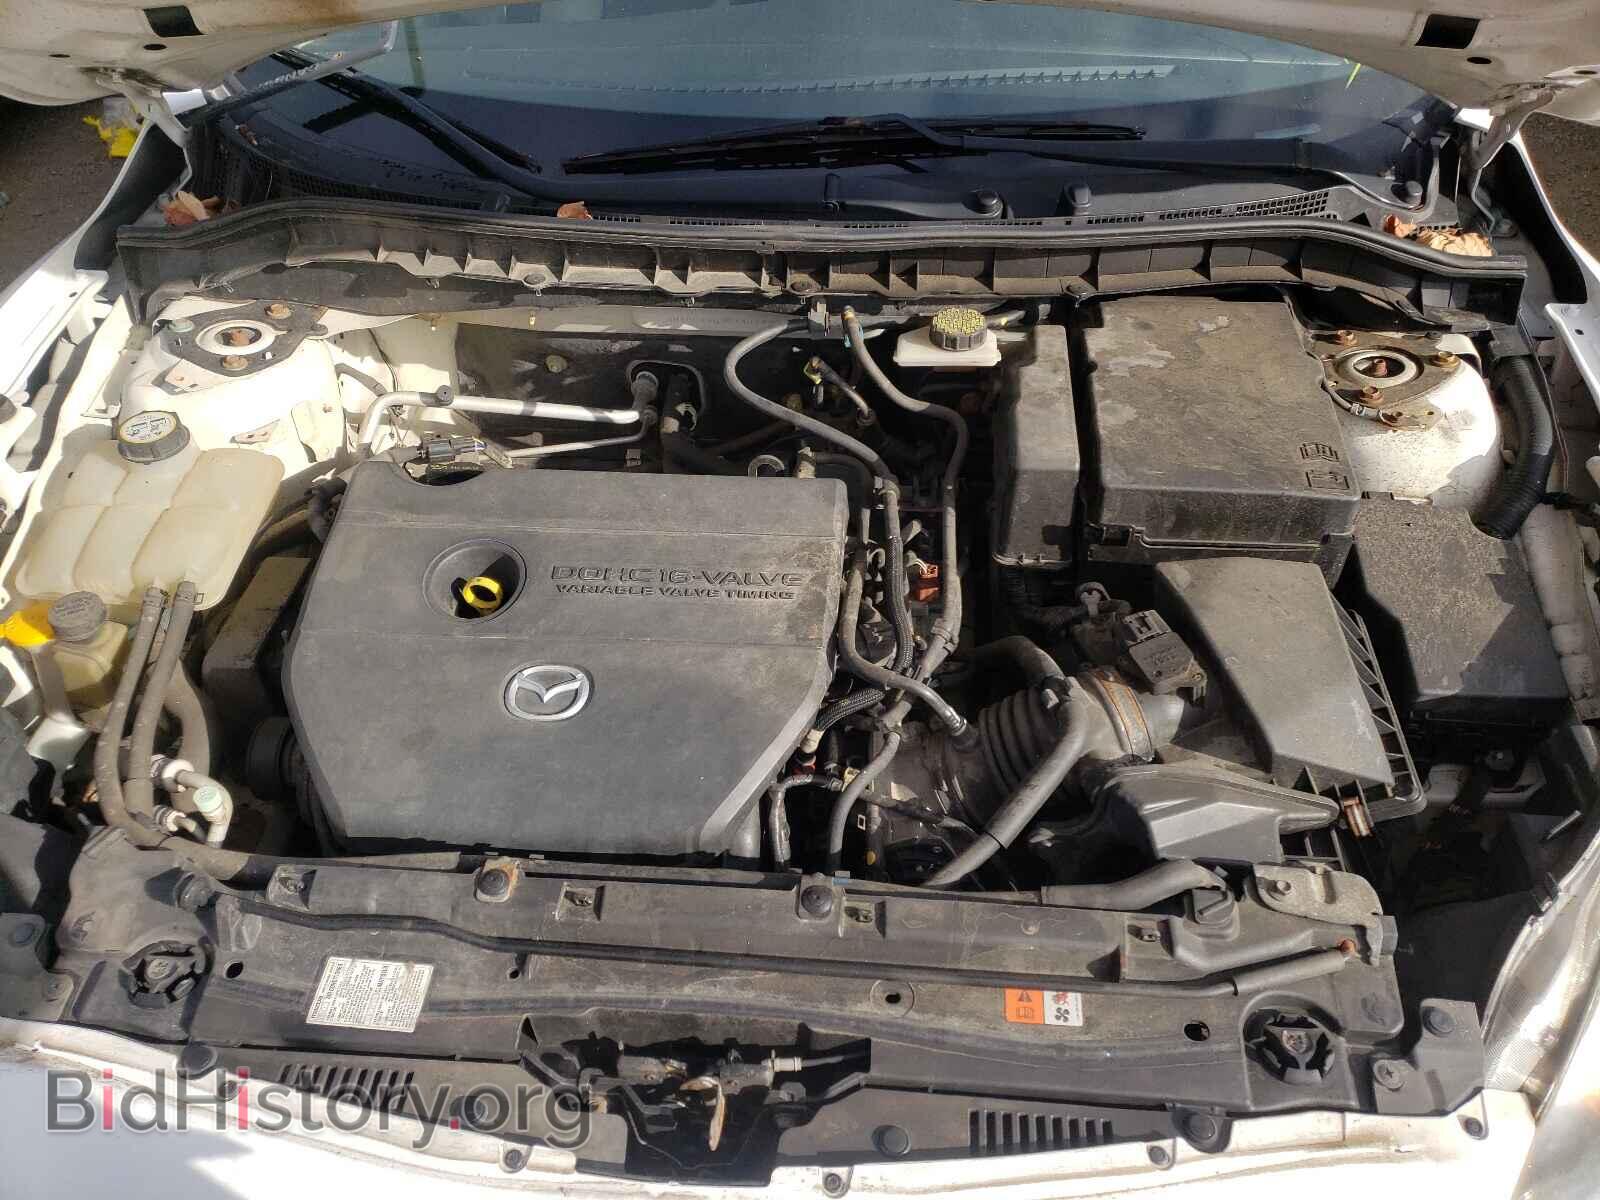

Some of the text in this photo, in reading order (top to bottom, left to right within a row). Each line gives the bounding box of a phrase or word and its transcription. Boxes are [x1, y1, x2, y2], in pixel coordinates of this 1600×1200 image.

[551, 565, 803, 587] DOHC 16-VALVE
[555, 583, 797, 600] VARIABLE VALVE TIMING
